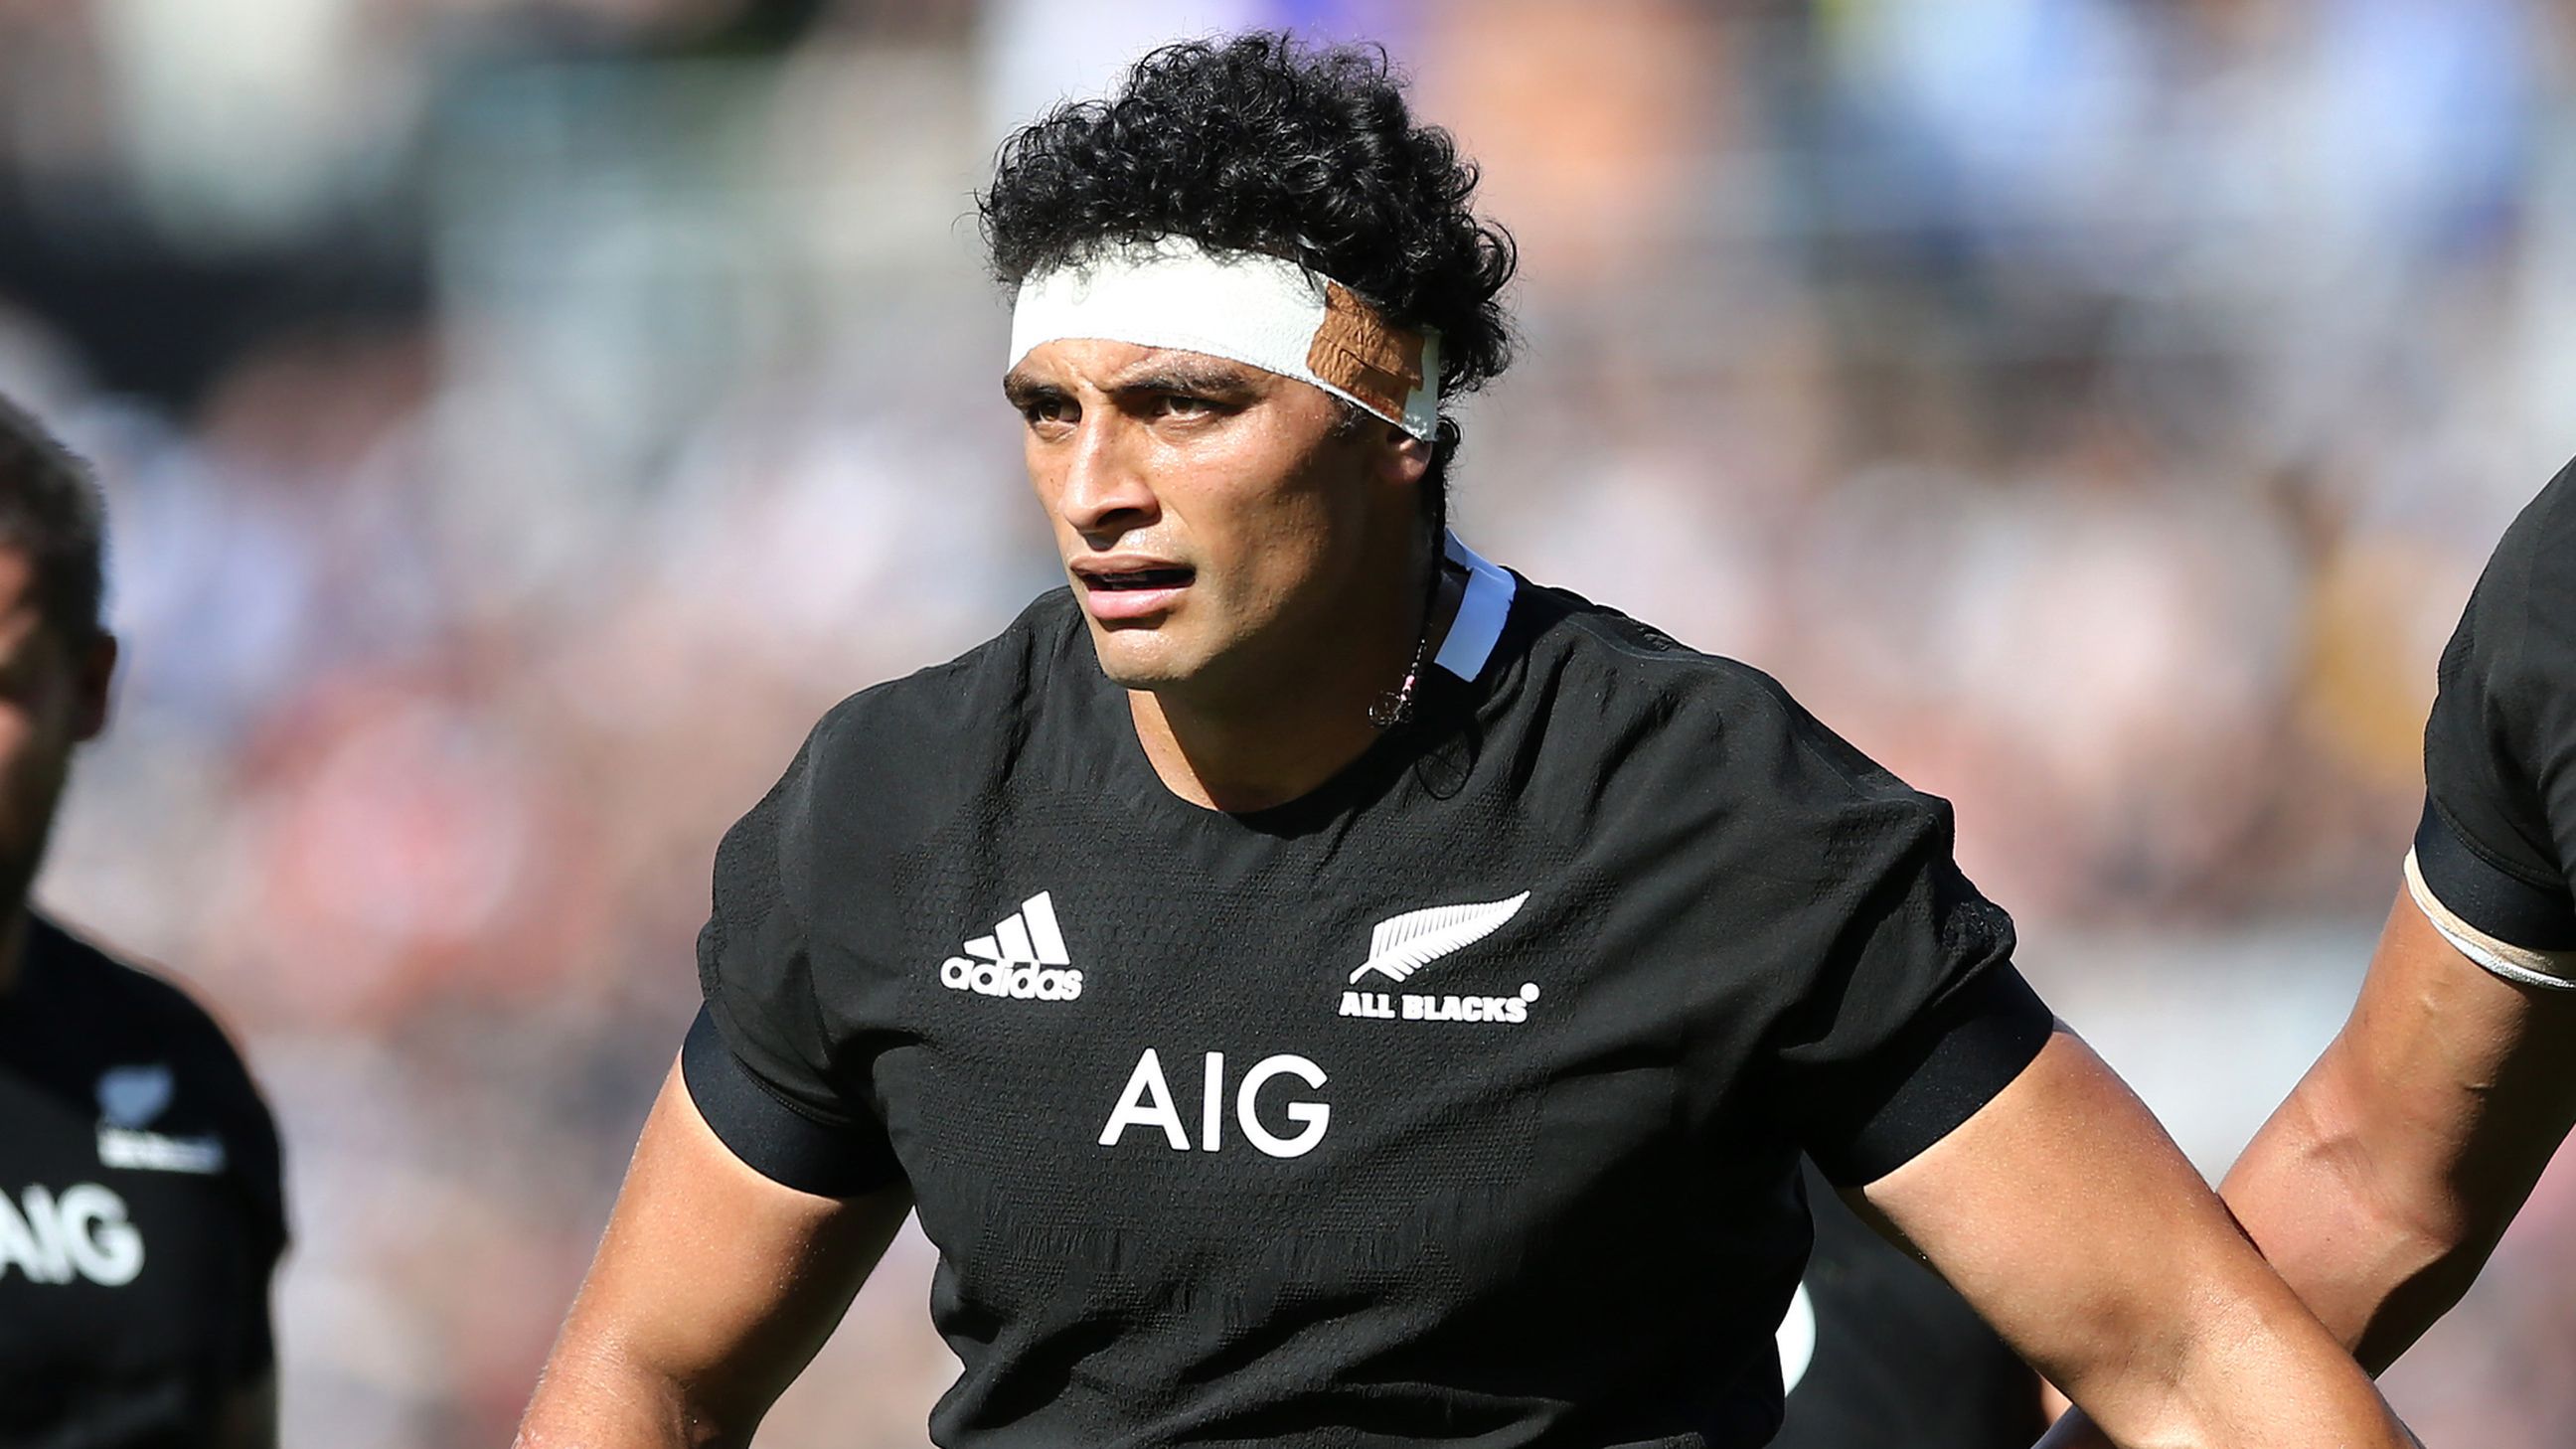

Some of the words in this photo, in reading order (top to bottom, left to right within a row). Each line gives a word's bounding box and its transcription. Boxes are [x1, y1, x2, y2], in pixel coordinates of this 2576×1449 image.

[940, 956, 1083, 1001] adidas
[1339, 991, 1395, 1019] ALL
[1401, 995, 1528, 1024] BLACKS
[1098, 1047, 1331, 1159] AIG
